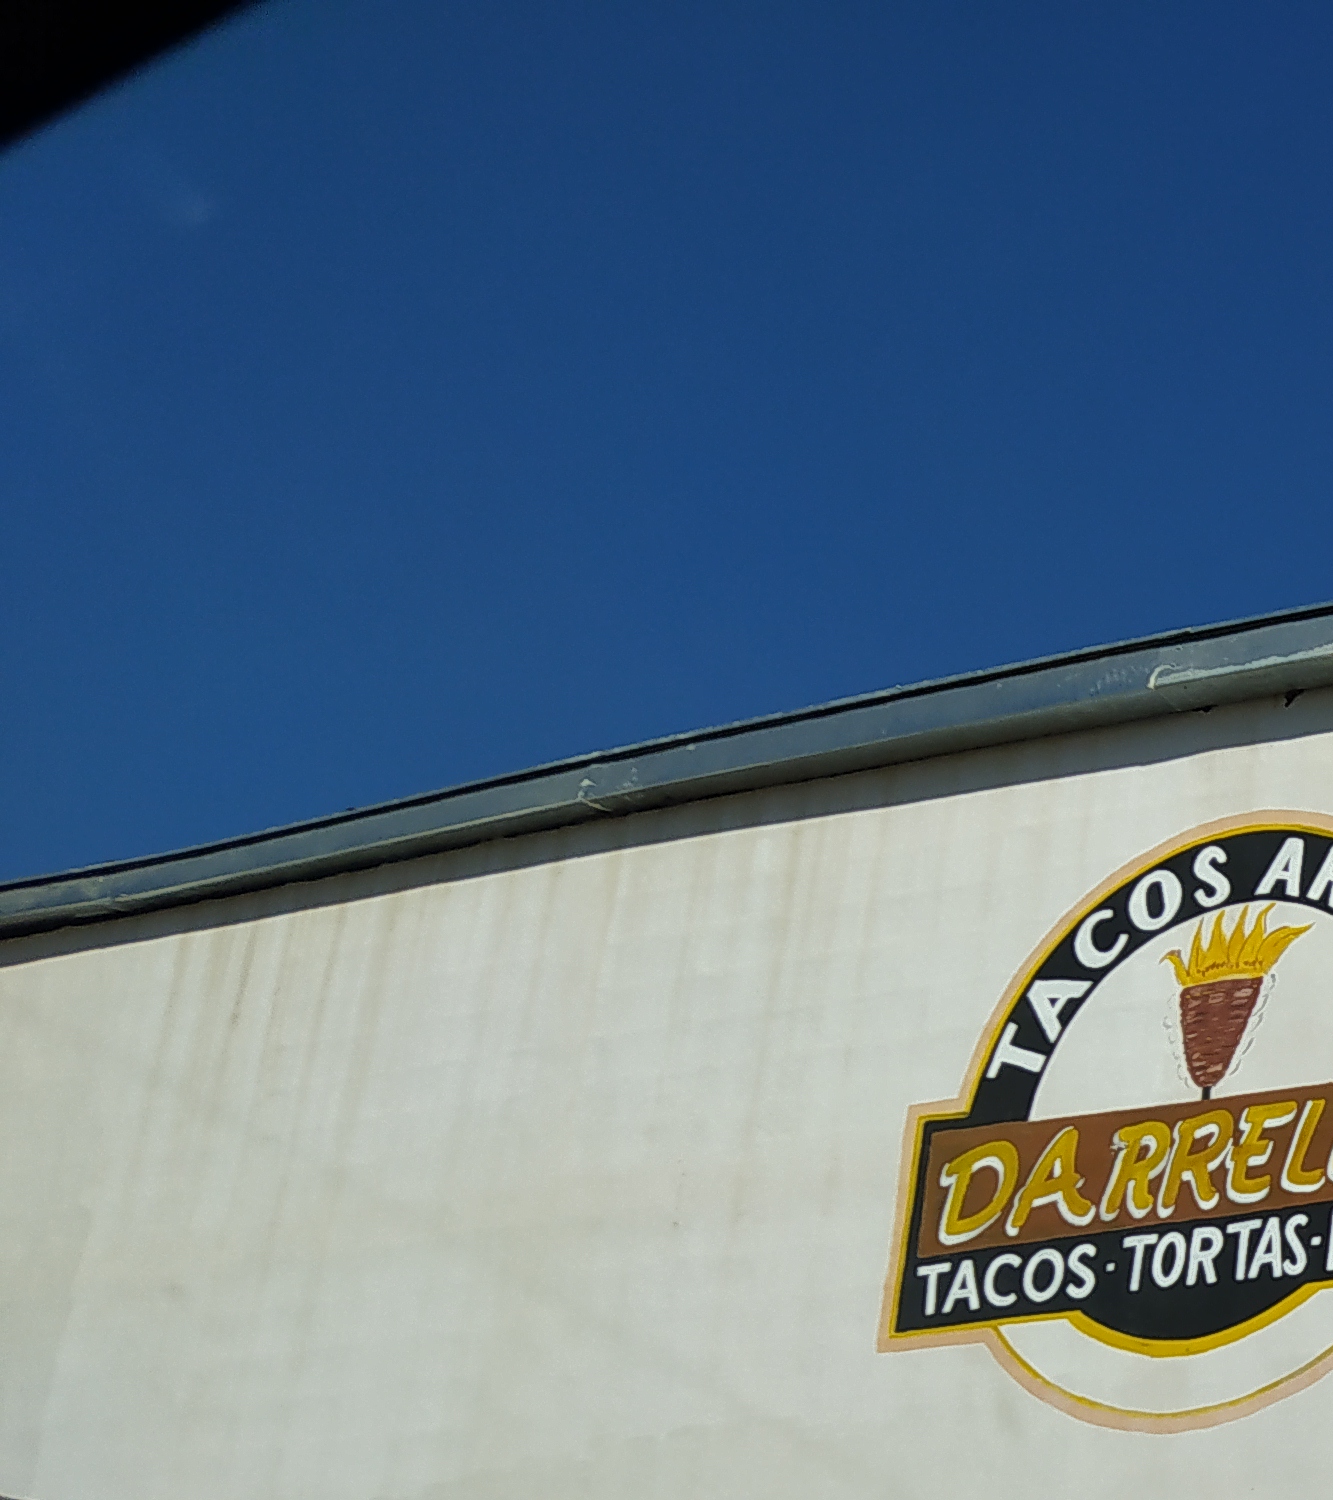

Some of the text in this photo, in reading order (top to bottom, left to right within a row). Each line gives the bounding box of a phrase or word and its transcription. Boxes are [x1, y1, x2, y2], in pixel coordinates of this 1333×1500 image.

[986, 845, 1232, 1081] TACOS
[917, 1243, 1097, 1316] TACOS
[1122, 1213, 1309, 1292] TORTAS
